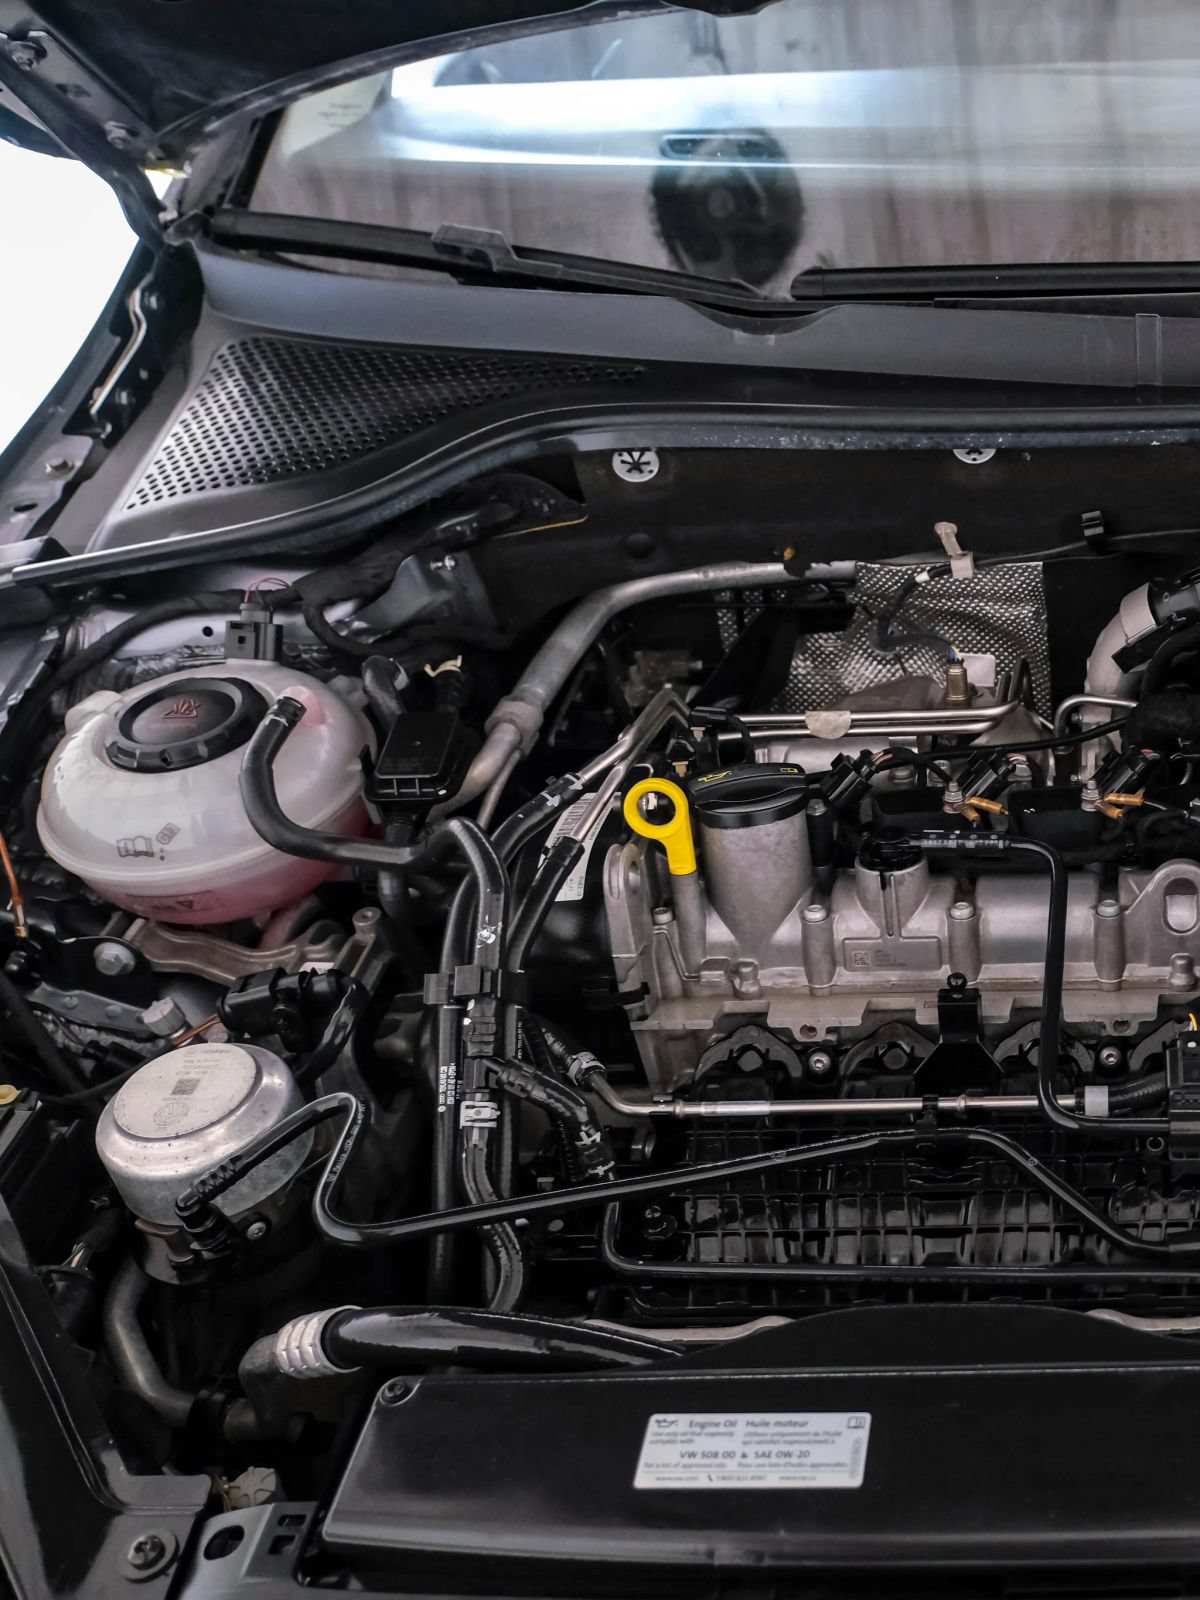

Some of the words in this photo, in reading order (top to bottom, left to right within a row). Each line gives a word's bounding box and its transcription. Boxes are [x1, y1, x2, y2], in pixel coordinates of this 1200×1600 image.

[689, 1419, 721, 1429] Engine
[724, 1419, 738, 1428] Oil
[746, 1419, 771, 1428] Huile
[773, 1419, 808, 1428] moteur
[680, 1451, 697, 1459] VW
[701, 1450, 719, 1459] 508
[721, 1450, 736, 1459] 00
[740, 1451, 748, 1459] &
[754, 1450, 772, 1459] SAE
